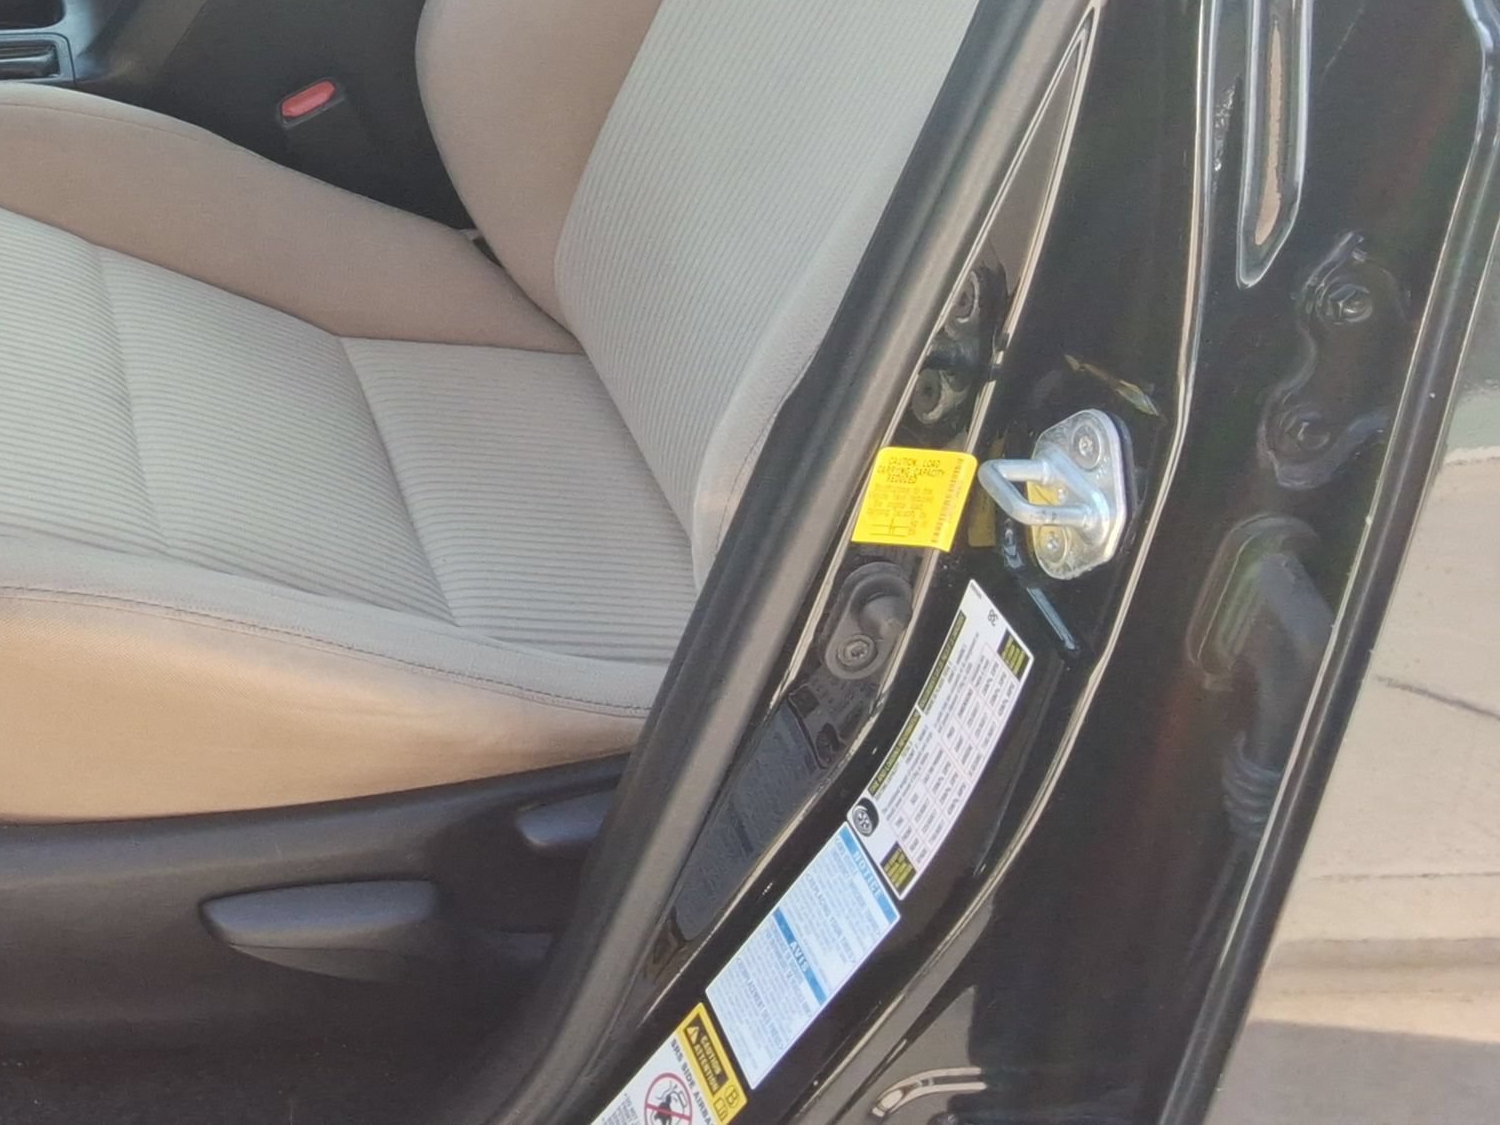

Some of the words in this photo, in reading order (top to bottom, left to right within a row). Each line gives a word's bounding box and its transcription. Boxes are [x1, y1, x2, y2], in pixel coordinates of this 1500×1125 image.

[789, 941, 809, 972] AVIS
[694, 1043, 720, 1093] ATTENTION
[700, 1035, 722, 1075] CAUTION
[671, 1038, 683, 1062] SRS
[681, 1062, 695, 1089] SIDE
[693, 1091, 714, 1125] AIRBA
